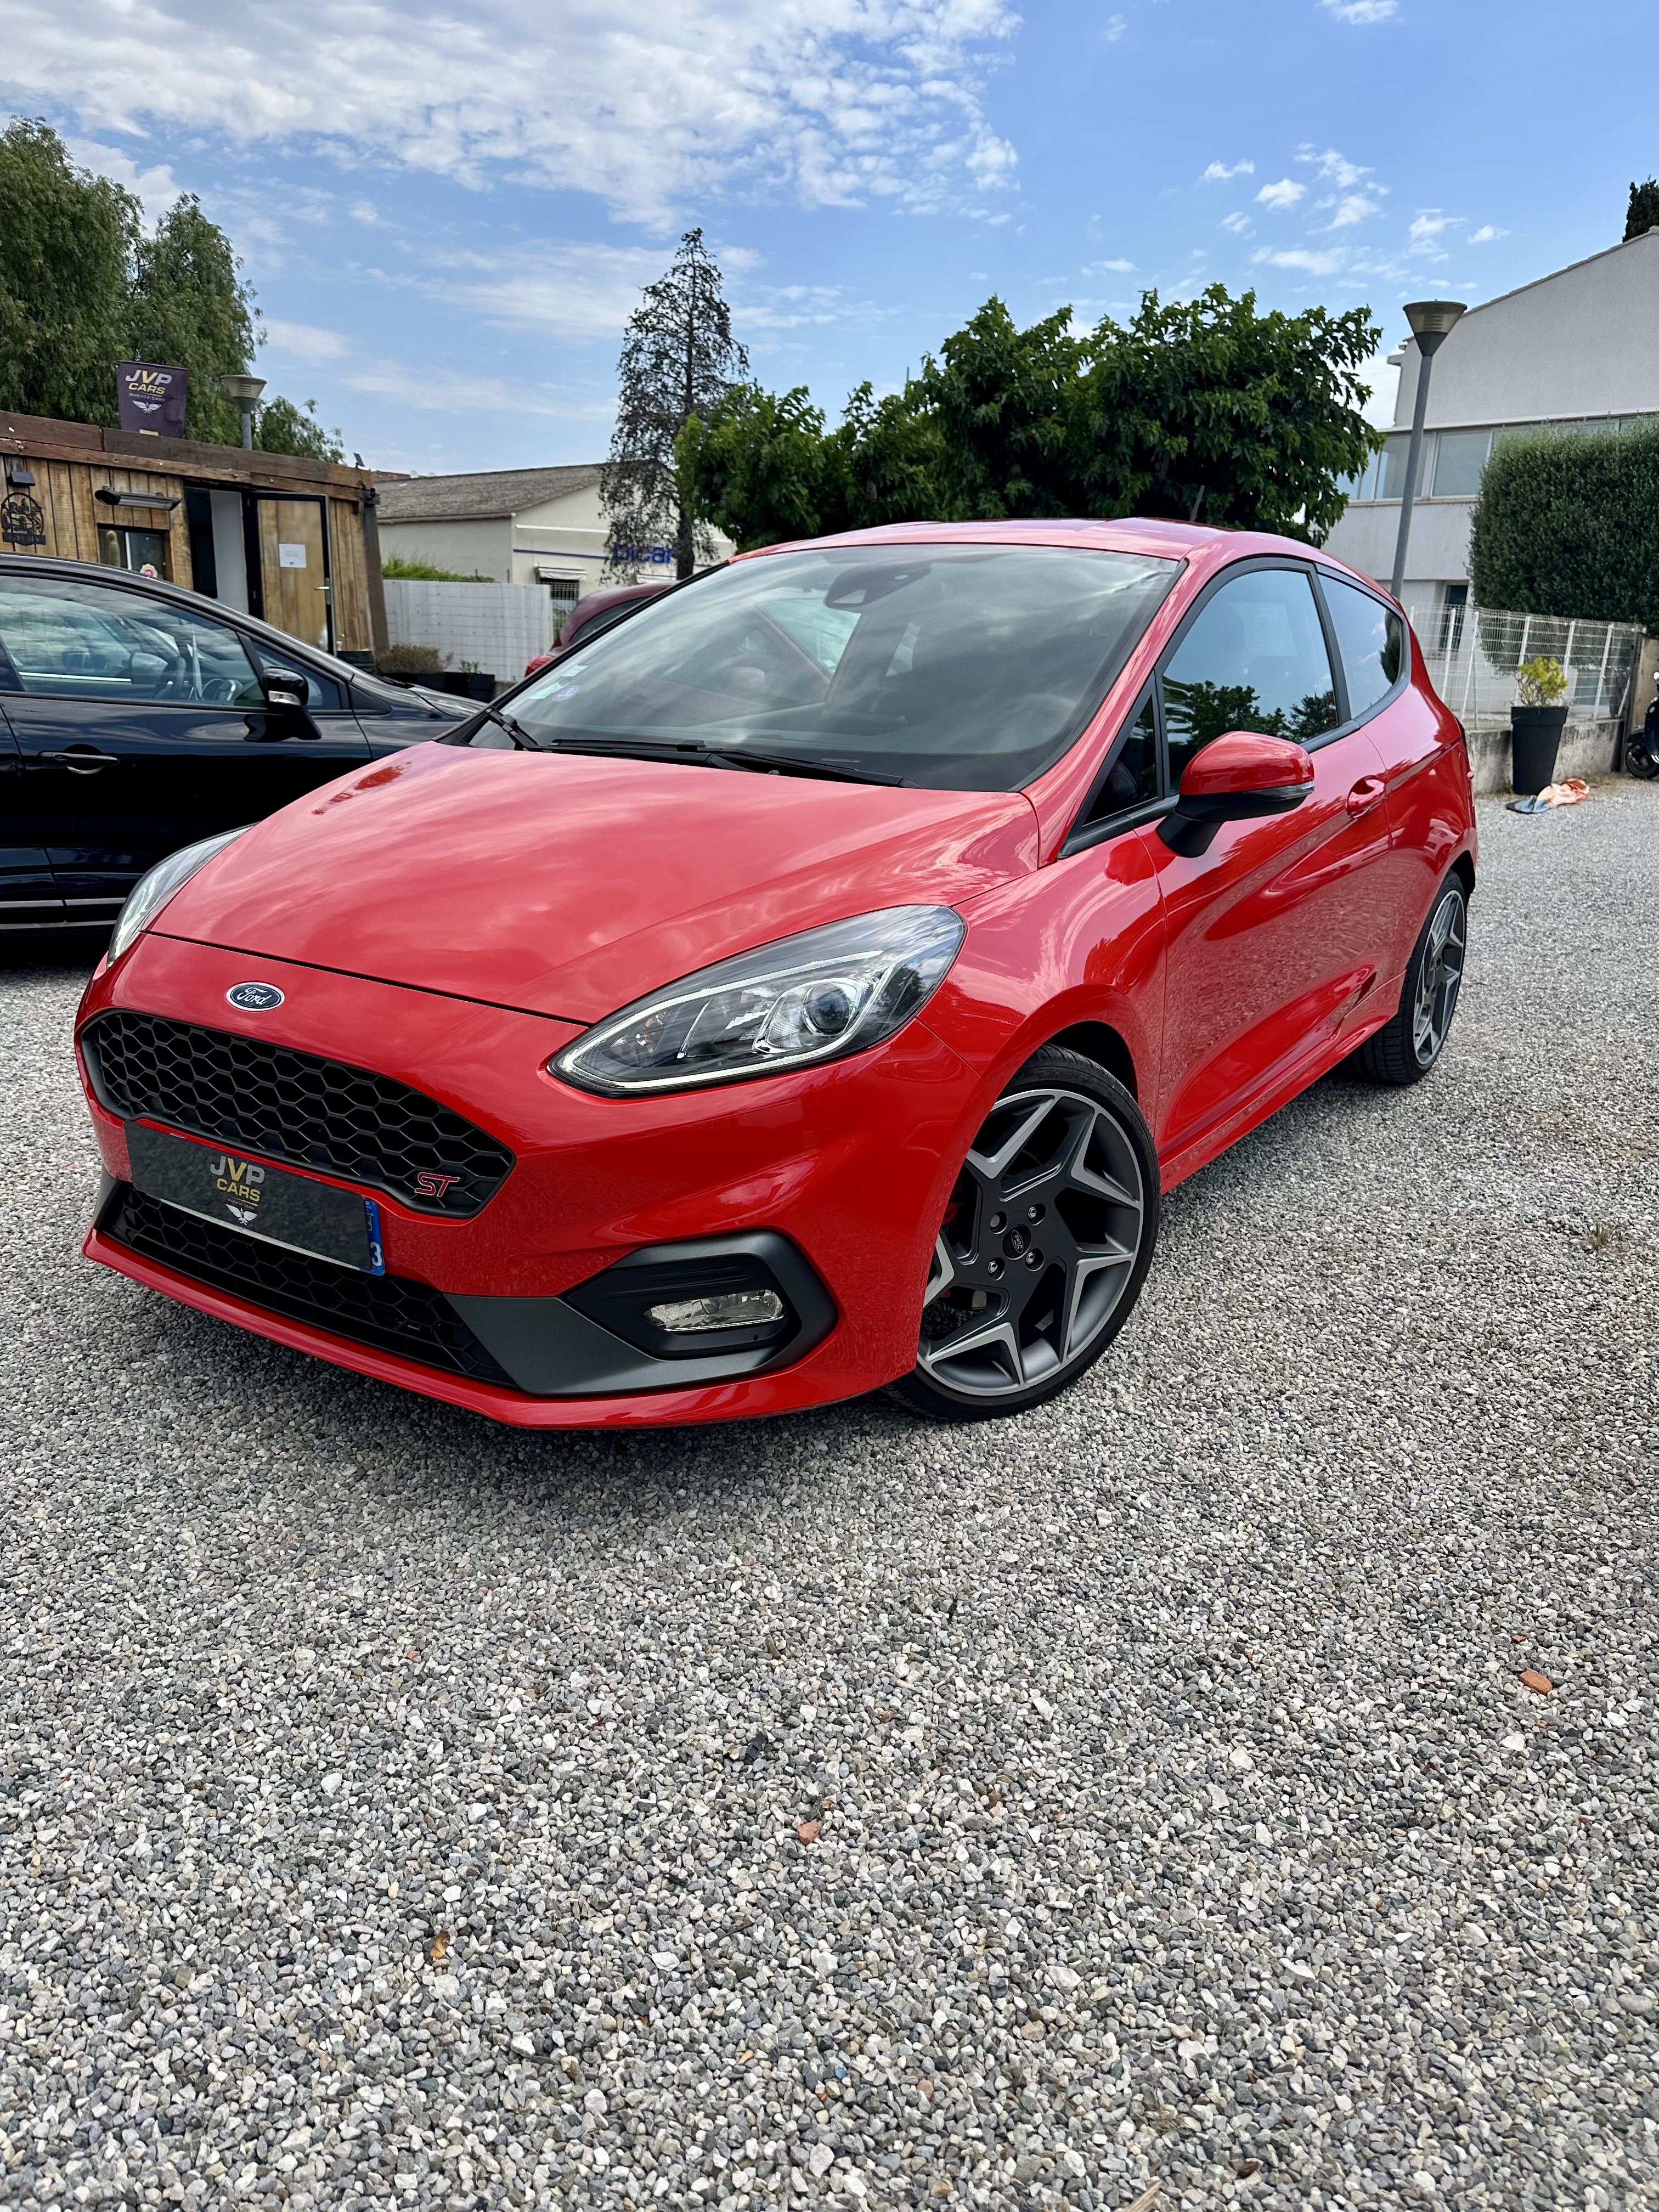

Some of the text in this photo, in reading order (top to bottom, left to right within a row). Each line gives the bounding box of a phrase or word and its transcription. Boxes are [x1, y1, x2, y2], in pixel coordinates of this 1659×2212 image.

[125, 370, 172, 385] JVP
[128, 382, 166, 394] CARS
[236, 987, 273, 1005] Ford
[210, 1155, 265, 1186] JVP
[217, 1178, 261, 1202] CARS
[414, 1172, 460, 1197] ST
